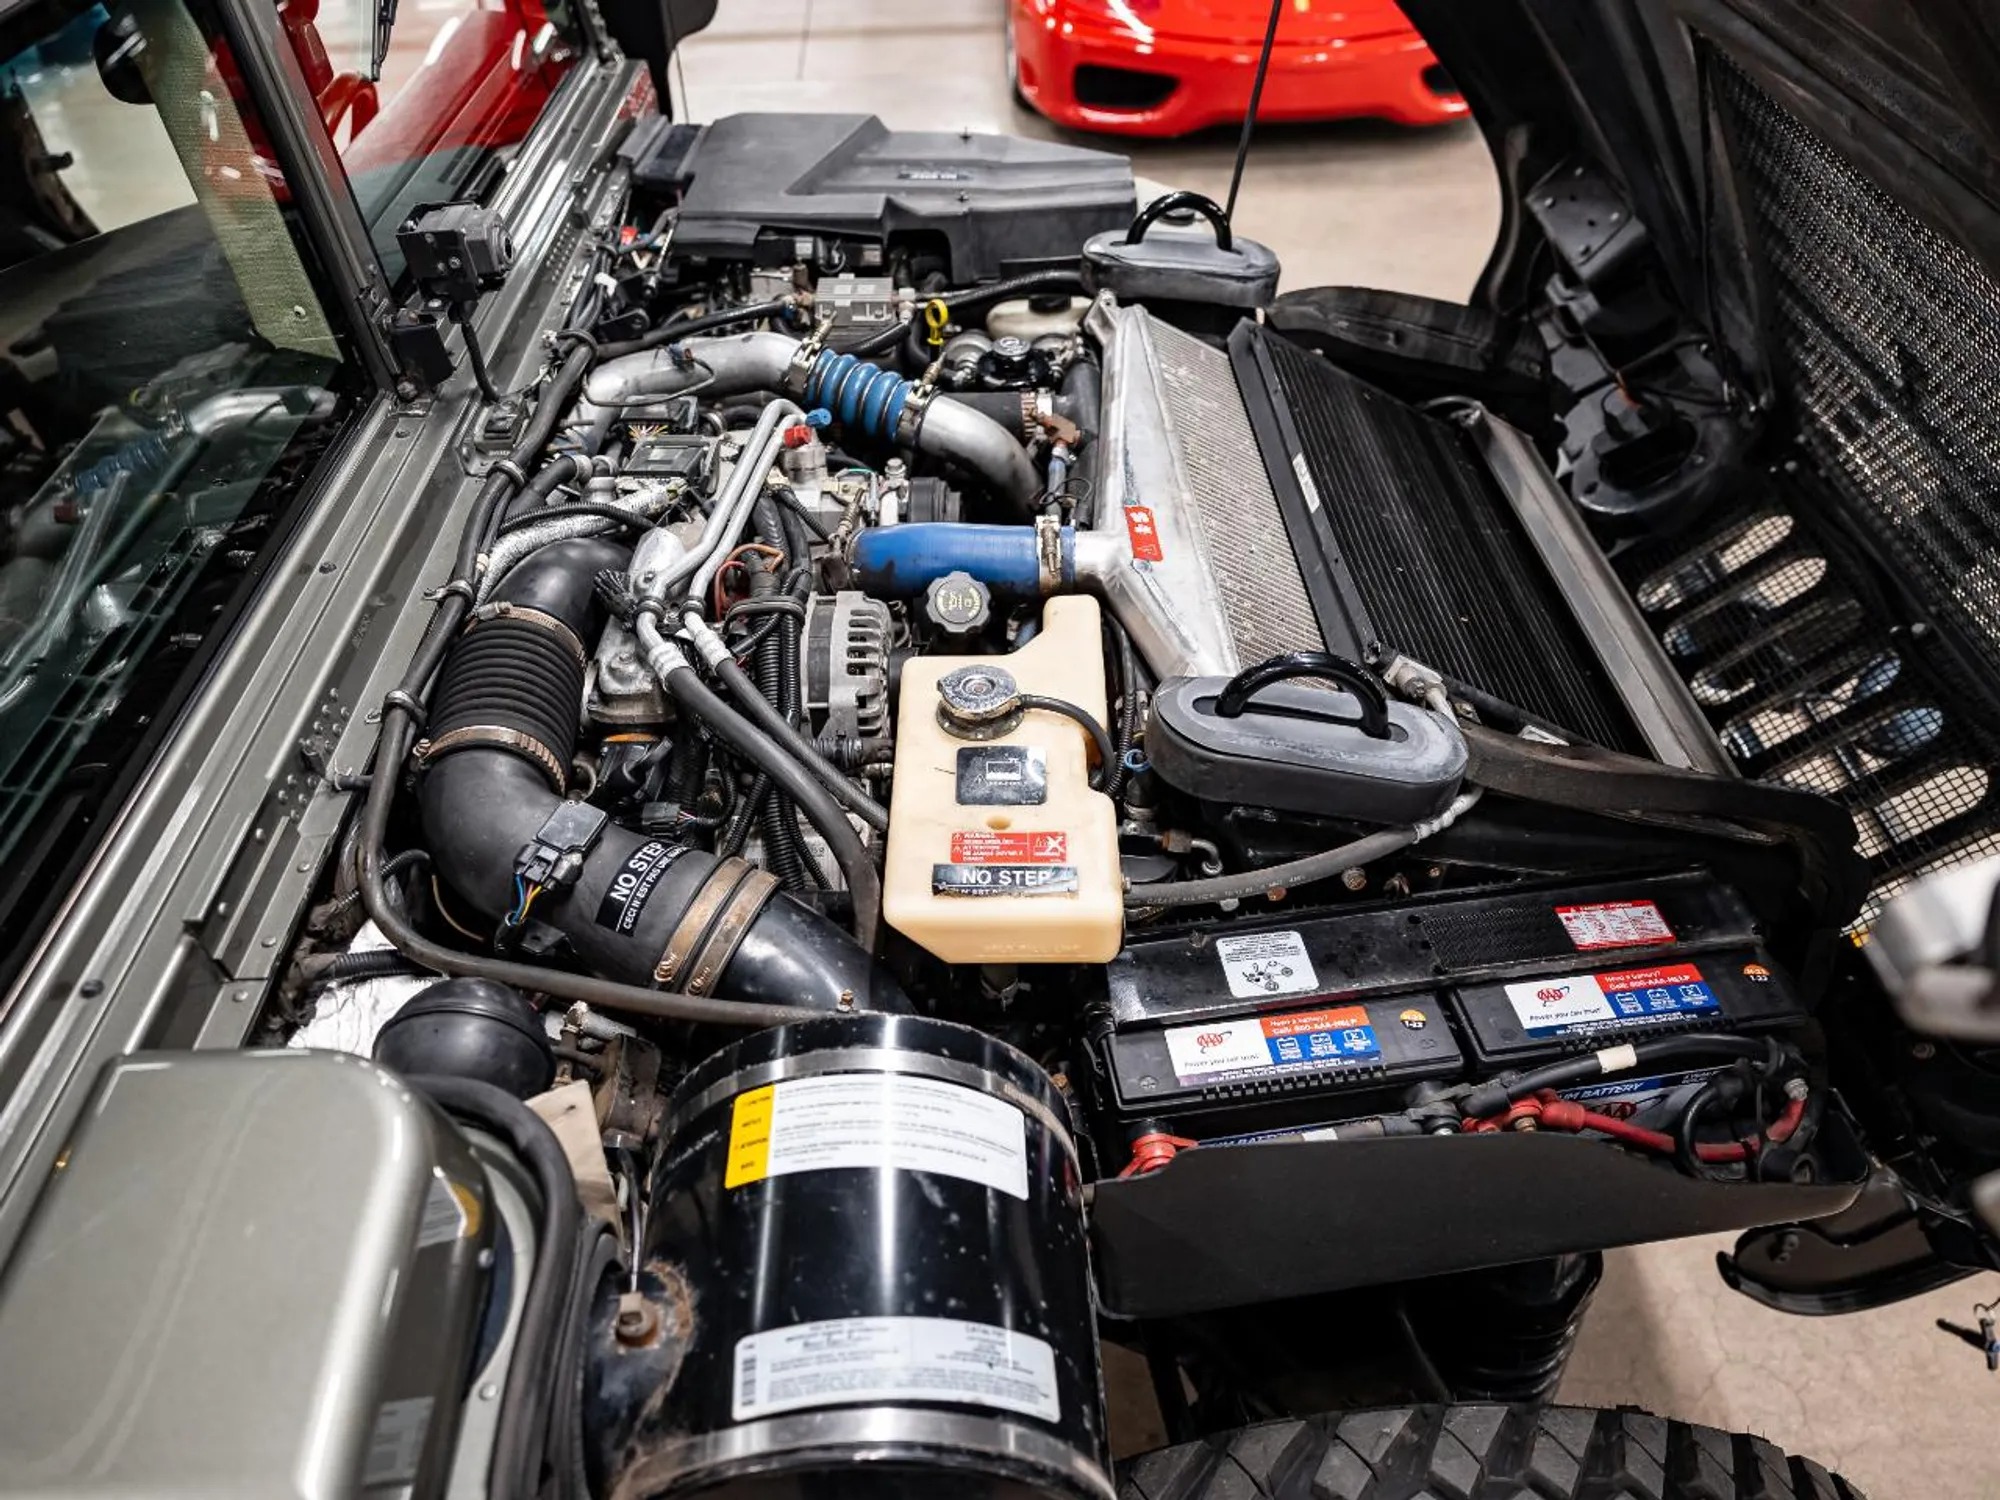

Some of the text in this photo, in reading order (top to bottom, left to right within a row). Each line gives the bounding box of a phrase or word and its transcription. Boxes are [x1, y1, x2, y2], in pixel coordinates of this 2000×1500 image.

[609, 841, 665, 902] NO STEP
[962, 869, 1050, 886] NO STEP
[1537, 987, 1564, 1003] AAA
[1196, 1032, 1224, 1048] AAA
[1580, 1081, 1645, 1099] BATTERY
